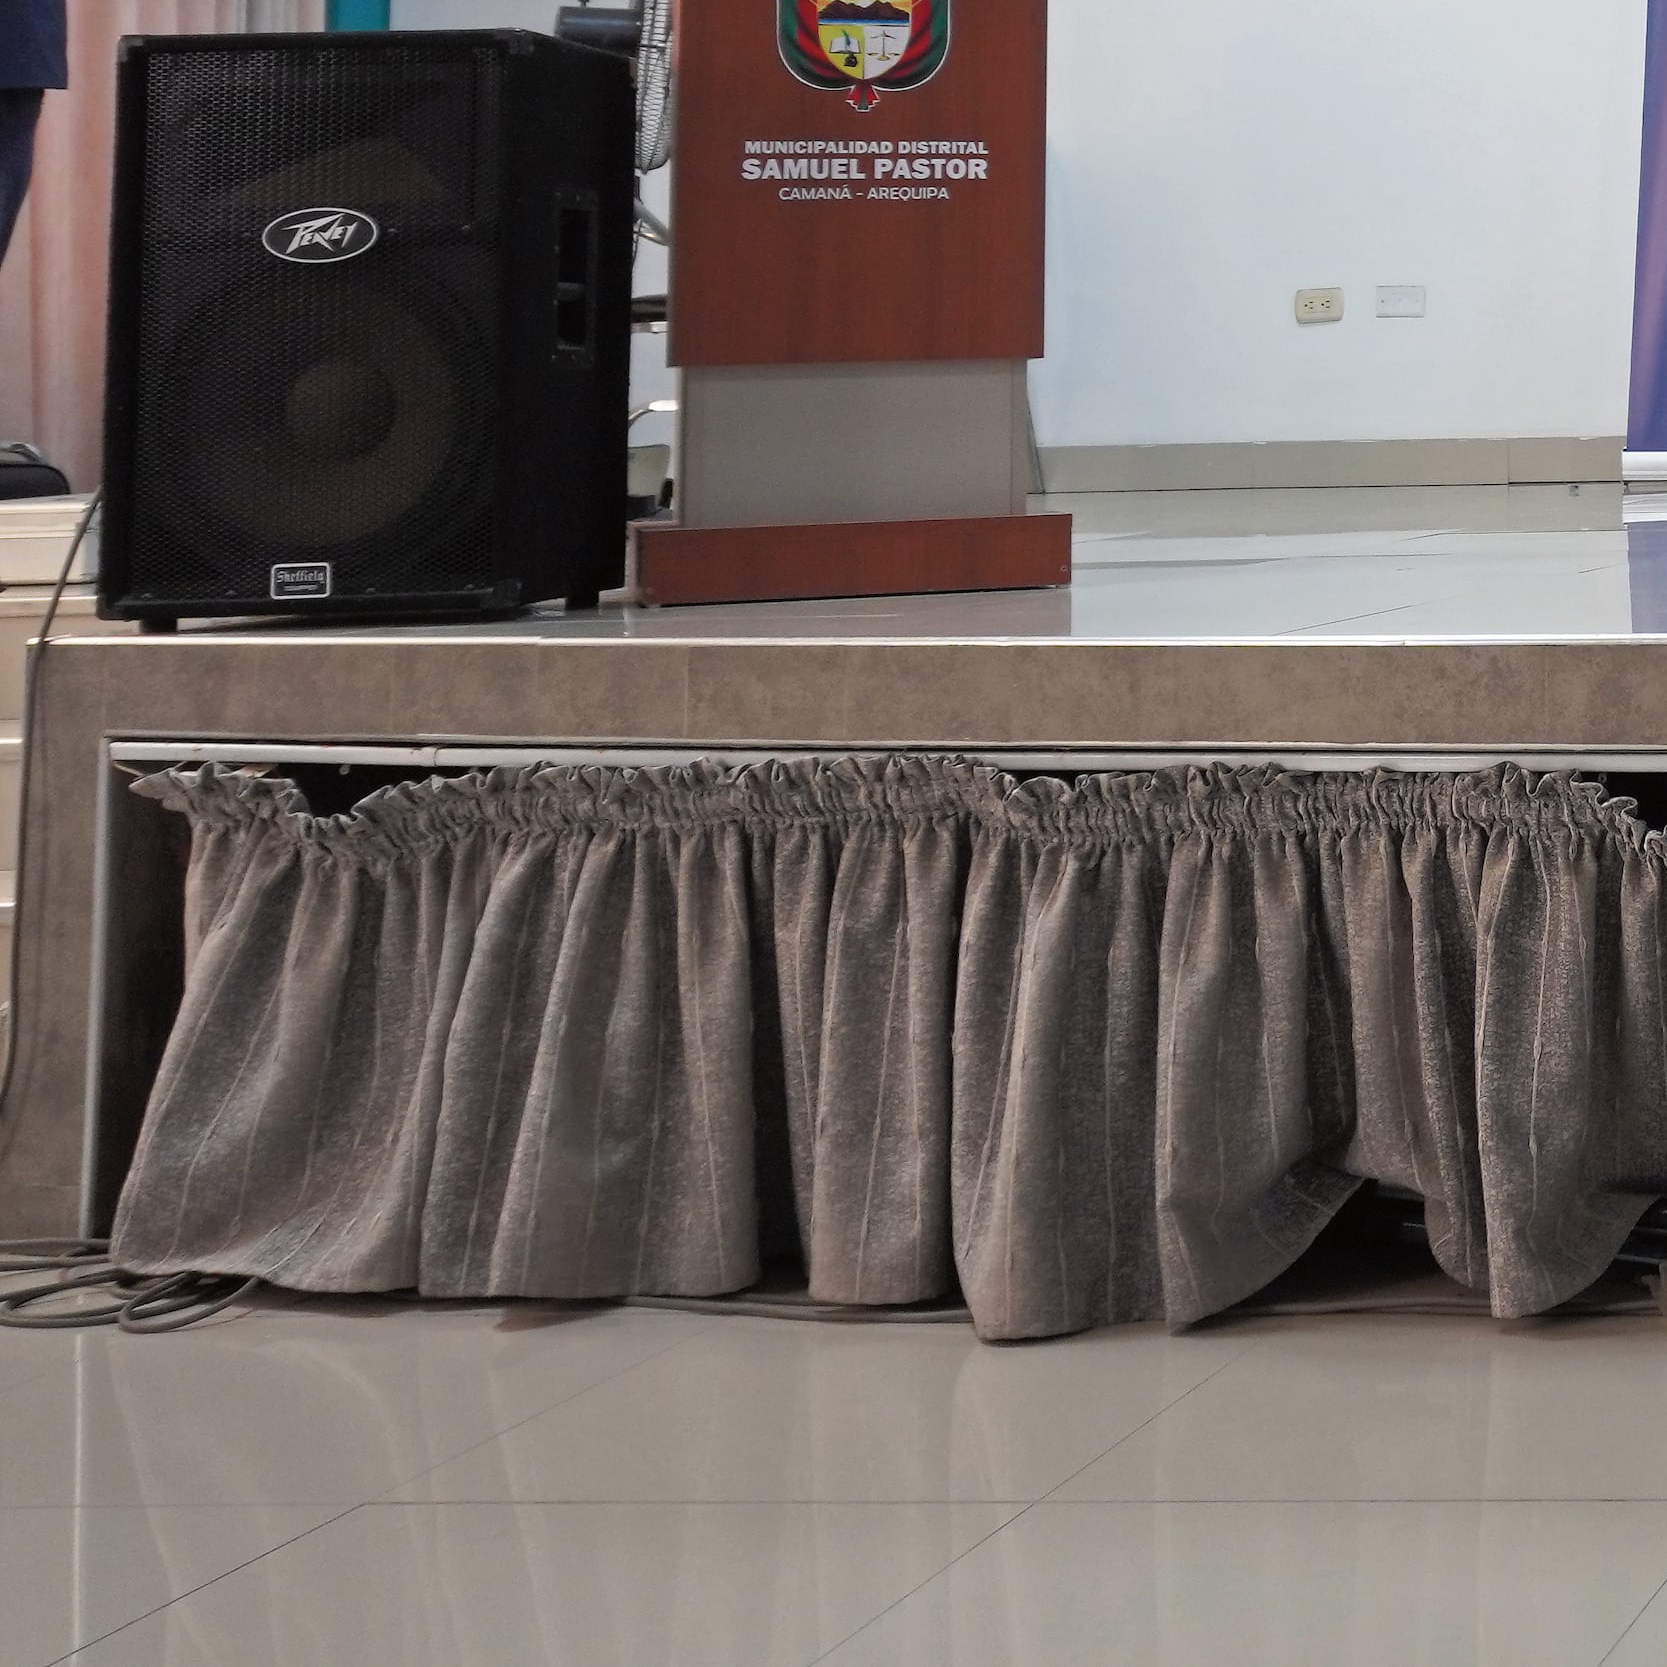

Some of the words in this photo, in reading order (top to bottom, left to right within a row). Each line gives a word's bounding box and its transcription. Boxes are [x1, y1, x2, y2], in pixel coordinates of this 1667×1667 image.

[744, 140, 894, 155] MUNICIPALIDAD
[897, 141, 989, 155] DISTRITAL
[741, 158, 866, 180] SAMUEL
[874, 158, 988, 180] PASTOR
[778, 184, 852, 201] CAMANÁ
[866, 185, 950, 202] AREQUIPA
[281, 213, 360, 255] PEAVEY
